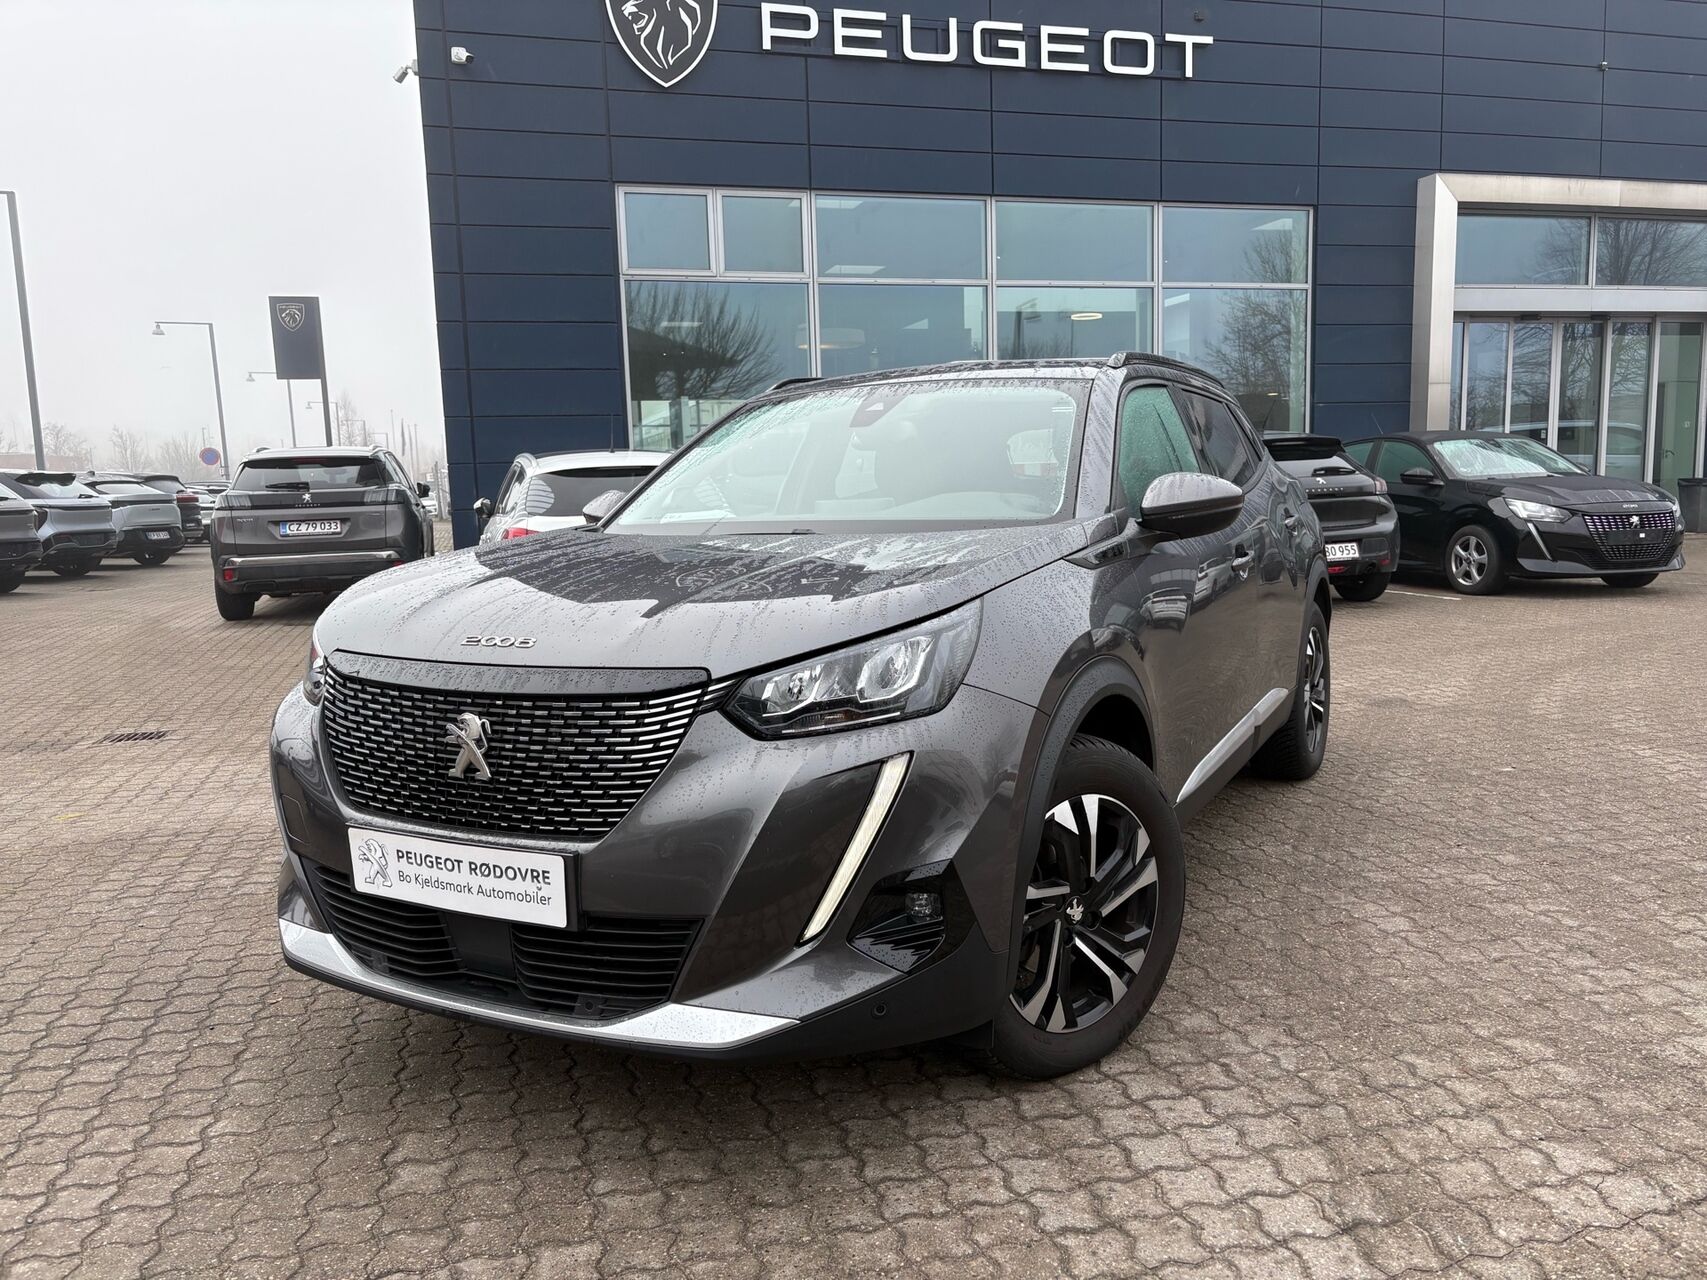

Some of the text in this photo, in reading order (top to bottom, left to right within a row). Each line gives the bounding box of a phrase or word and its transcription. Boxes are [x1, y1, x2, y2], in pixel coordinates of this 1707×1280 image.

[760, 2, 1214, 79] PEUGEOT
[288, 521, 339, 532] CZ 79 033
[1338, 544, 1357, 556] 955
[460, 634, 538, 649] 2008
[396, 849, 551, 886] PEUGEOT RØDOVRE
[398, 870, 552, 906] Bo Kjeldsmark Automobiler
